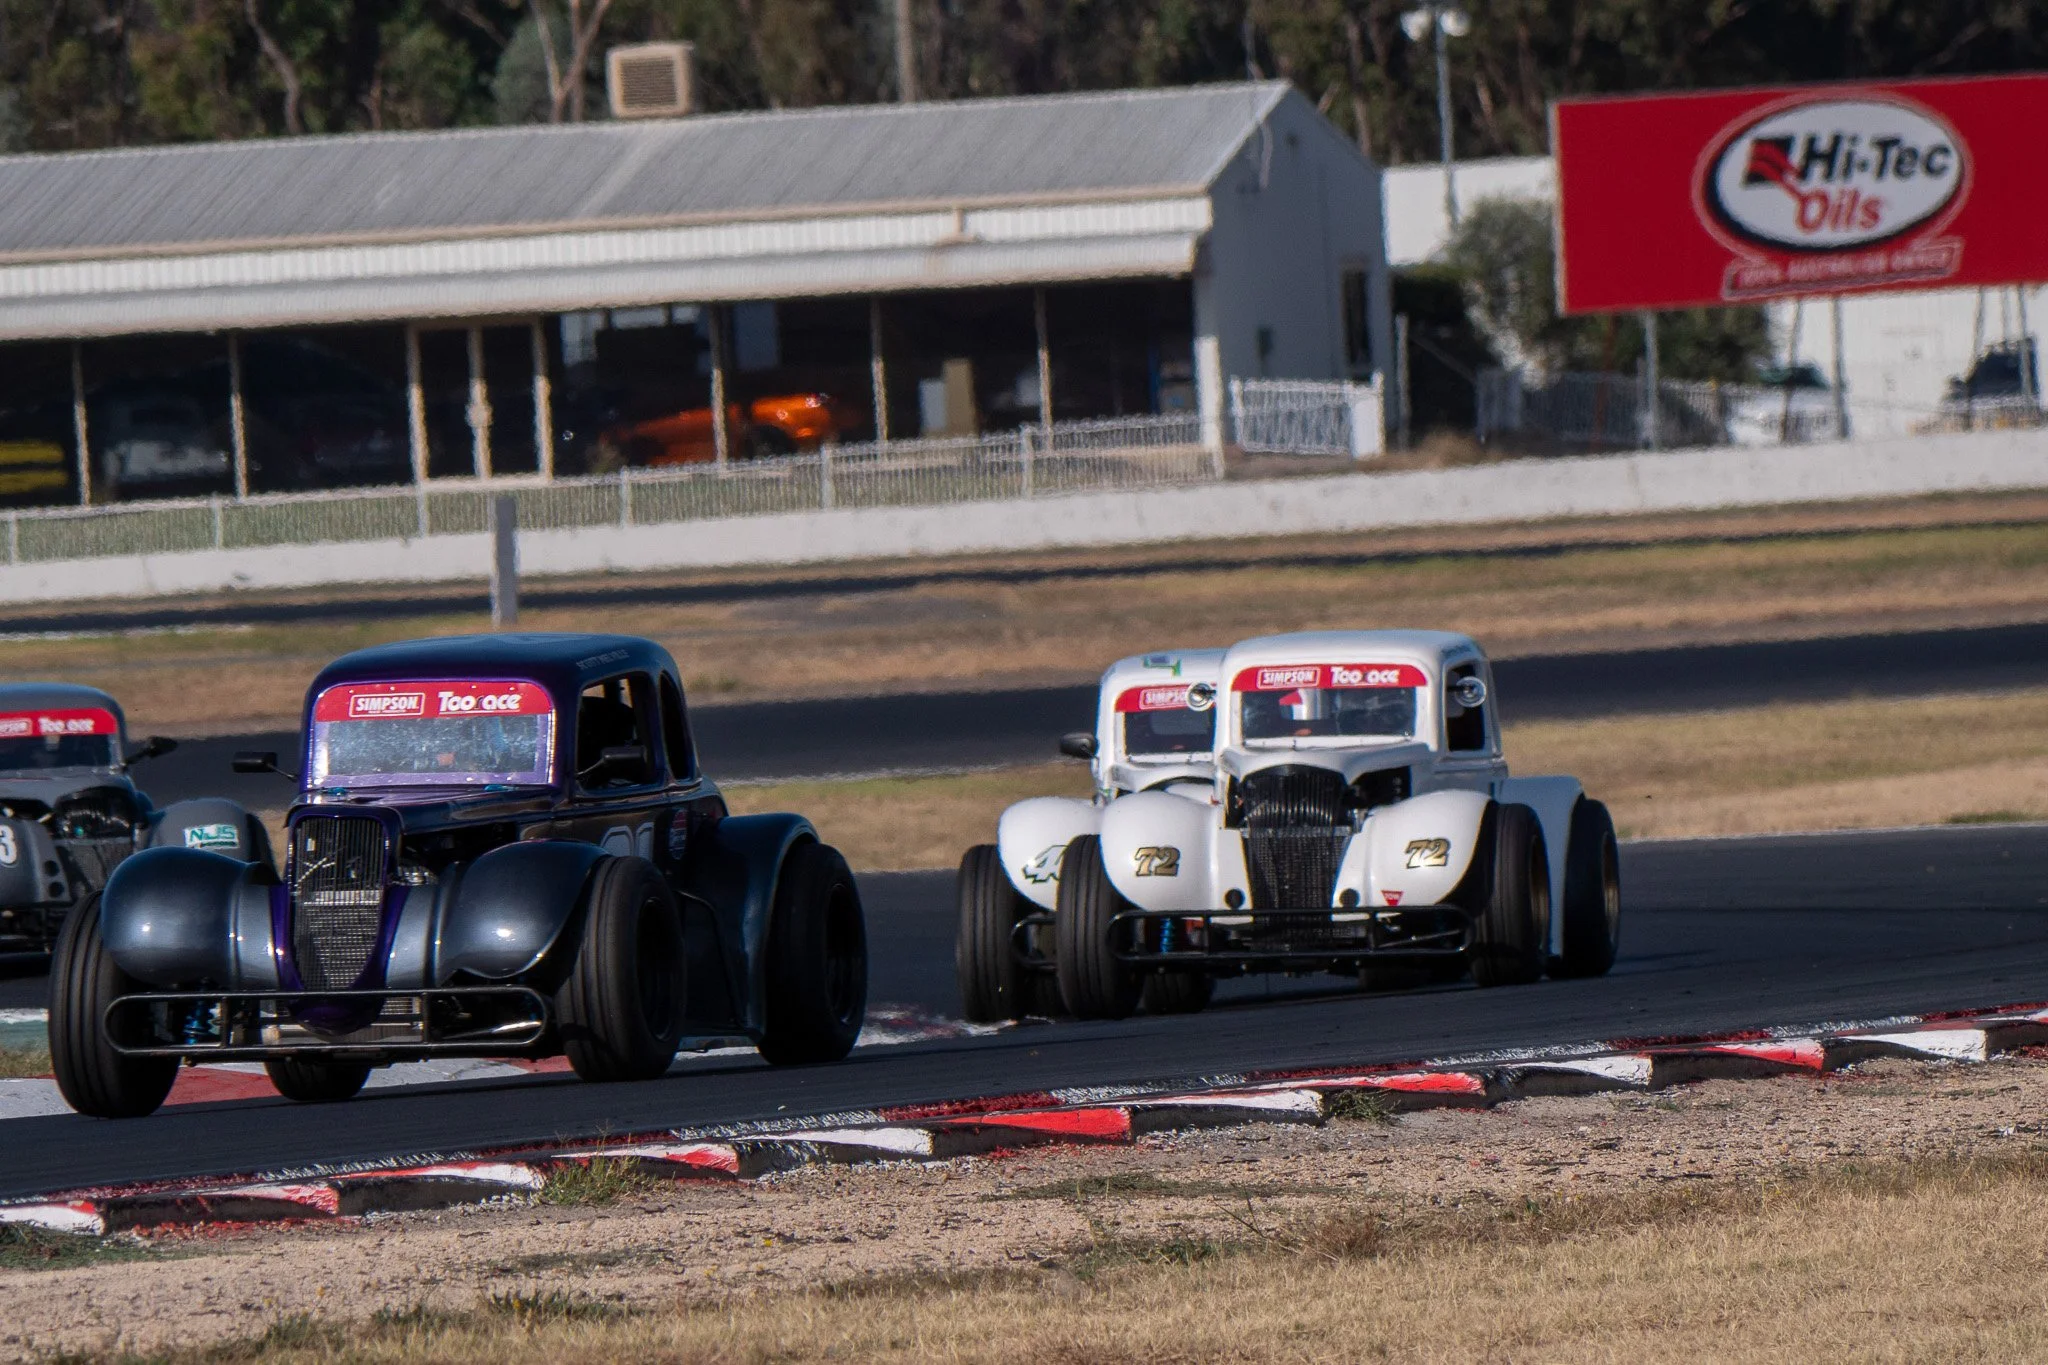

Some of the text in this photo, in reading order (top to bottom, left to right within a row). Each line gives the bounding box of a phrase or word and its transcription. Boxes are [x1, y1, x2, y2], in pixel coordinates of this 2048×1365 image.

[1796, 188, 1882, 233] Oils
[1262, 670, 1314, 684] SIMPSON
[355, 696, 419, 711] SIMPSON
[1146, 688, 1187, 704] SIMPSO
[1135, 846, 1180, 876] 72
[1405, 838, 1450, 868] 72
